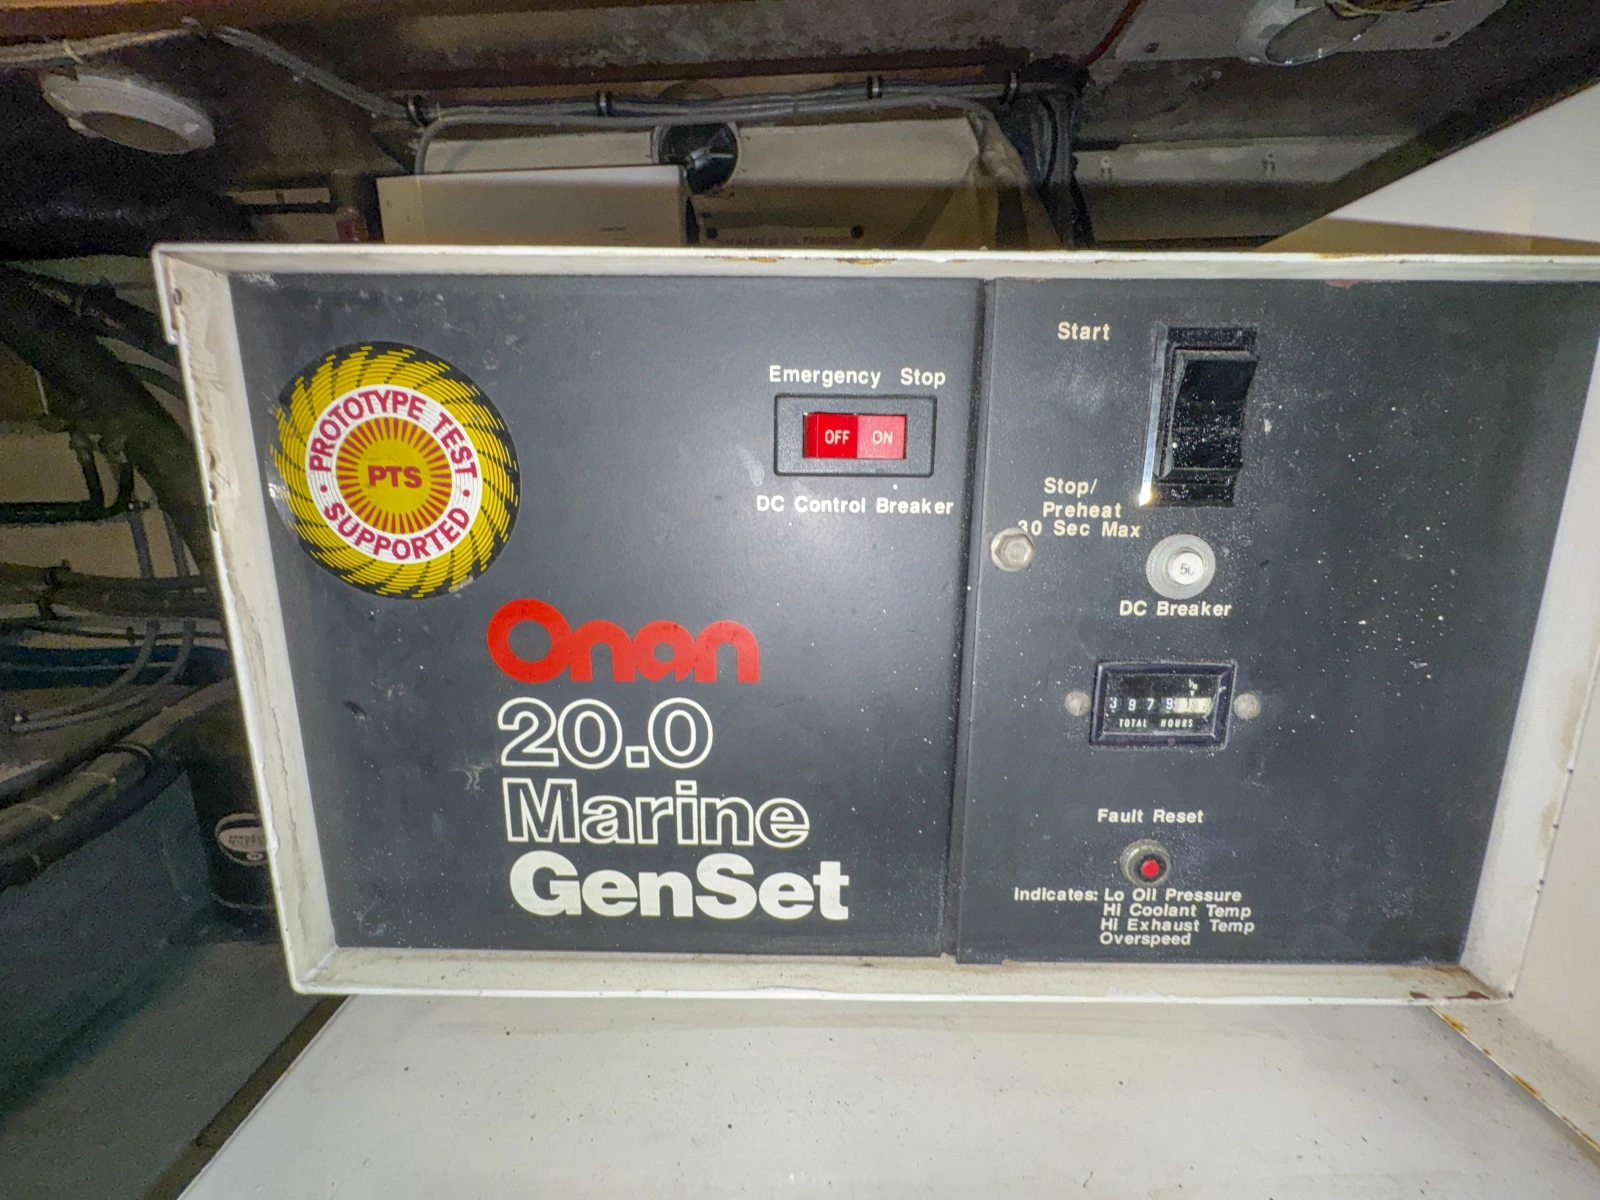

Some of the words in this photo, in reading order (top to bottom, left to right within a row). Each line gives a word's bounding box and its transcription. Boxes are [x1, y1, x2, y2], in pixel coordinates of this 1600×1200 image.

[1057, 322, 1111, 341] Start
[769, 365, 882, 388] Emergency
[900, 367, 946, 388] Stop
[309, 390, 427, 472] PROTOTYPE
[432, 412, 478, 479] TEST
[824, 429, 850, 445] OFF
[872, 429, 894, 445] ON
[368, 466, 423, 488] PTS
[1043, 477, 1098, 498] Stop/
[756, 495, 785, 511] DC
[794, 496, 866, 514] Control
[876, 497, 954, 515] Breaker
[1042, 501, 1122, 518] Preheat
[324, 502, 470, 560] SUPPORTED
[1018, 520, 1042, 536] 30
[1053, 520, 1091, 537] Sec
[1101, 521, 1141, 538] Max
[1119, 600, 1147, 616] DC
[1156, 600, 1232, 617] Breaker
[486, 597, 760, 683] Onan
[1119, 718, 1148, 728] TOTAL
[1160, 718, 1194, 728] HOURS
[497, 697, 714, 769] 20.0
[502, 777, 810, 848] Marine
[1097, 808, 1144, 823] Fault
[1152, 809, 1204, 823] Reset
[509, 850, 850, 920] GenSet
[1013, 887, 1098, 901] Indicates:
[1104, 888, 1125, 901] Lo
[1132, 888, 1157, 901] Oil
[1165, 888, 1242, 902] Pressure
[1103, 903, 1121, 917] Hi
[1129, 903, 1197, 917] Coolant
[1206, 904, 1252, 920] Temp
[1101, 918, 1118, 931] Hi
[1127, 918, 1200, 932] Exhaust
[1209, 919, 1255, 935] Temp
[1100, 932, 1191, 947] Overspeed
